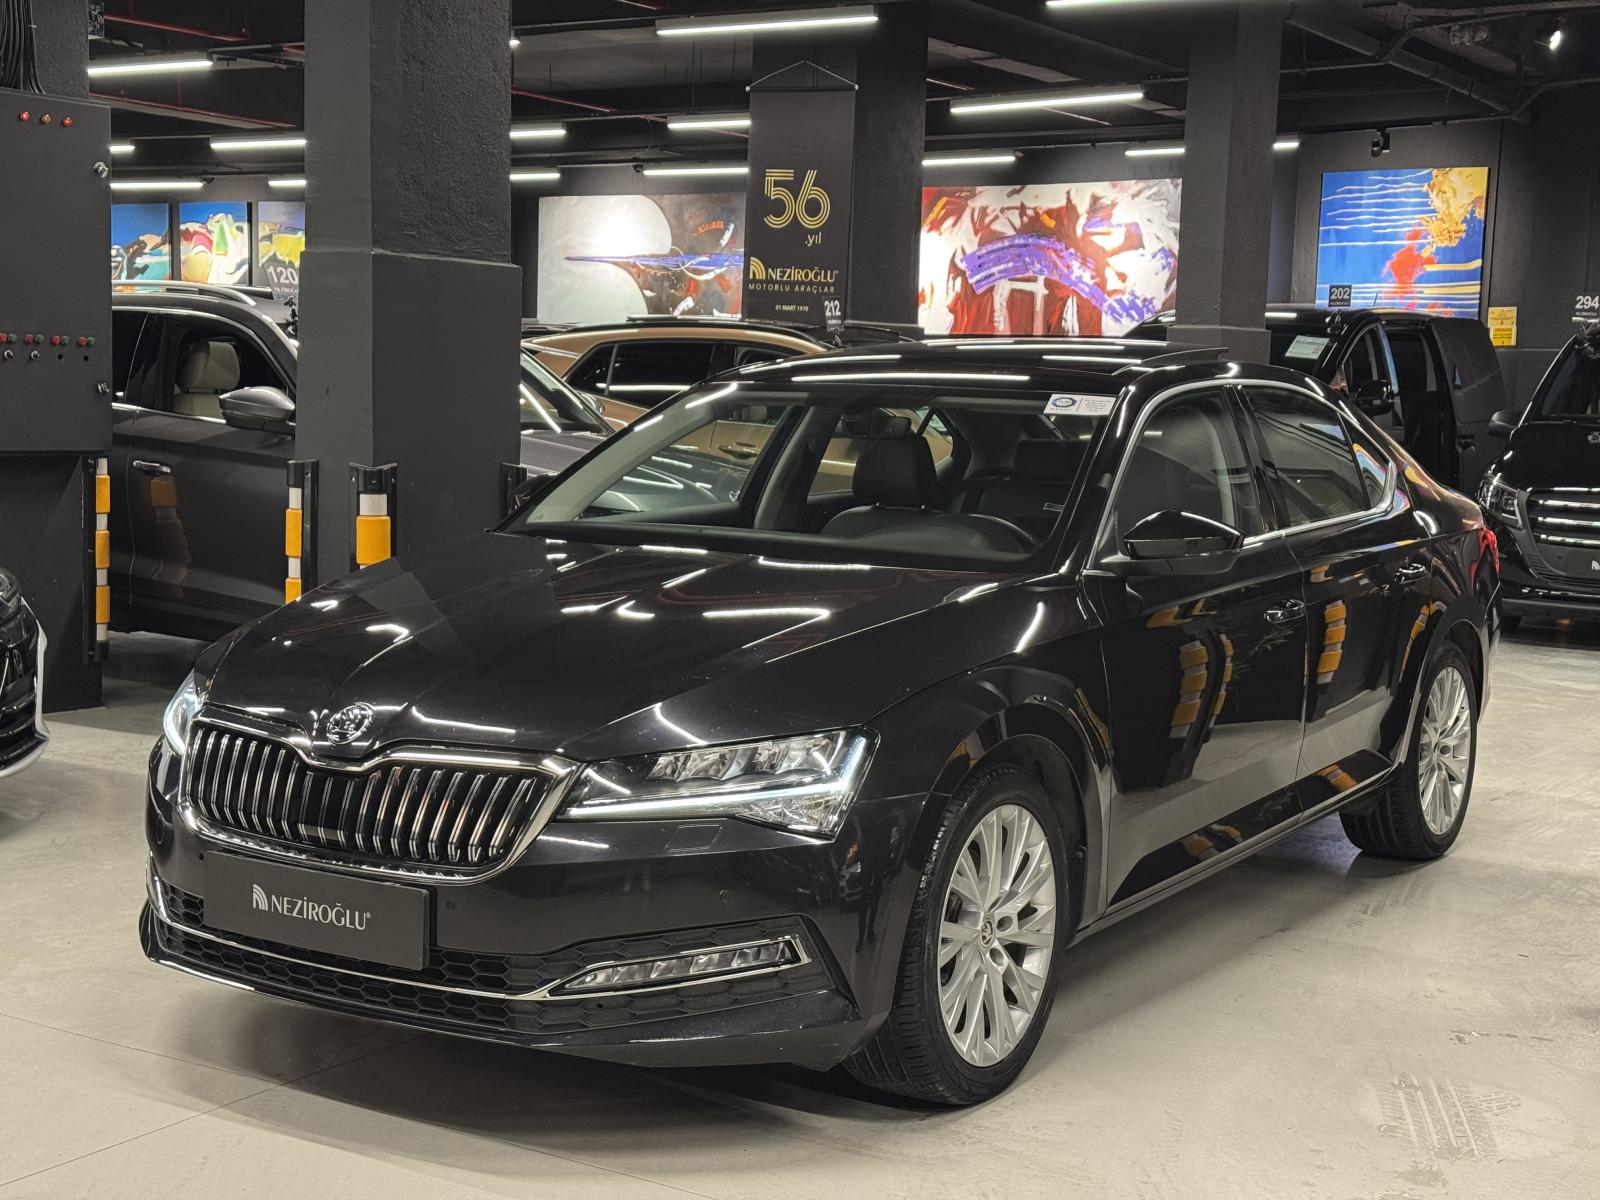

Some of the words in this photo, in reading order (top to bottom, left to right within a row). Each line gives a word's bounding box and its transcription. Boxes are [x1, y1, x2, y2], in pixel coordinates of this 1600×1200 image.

[763, 168, 831, 229] 56
[267, 265, 298, 284] 120
[767, 265, 835, 283] NEZİROĞLU
[748, 283, 790, 292] MOTORLU
[794, 286, 835, 295] ARAÇLAR
[1331, 287, 1350, 299] 202
[824, 300, 841, 316] 212
[1575, 295, 1599, 309] 294
[271, 894, 366, 930] NEZİROĞLU
